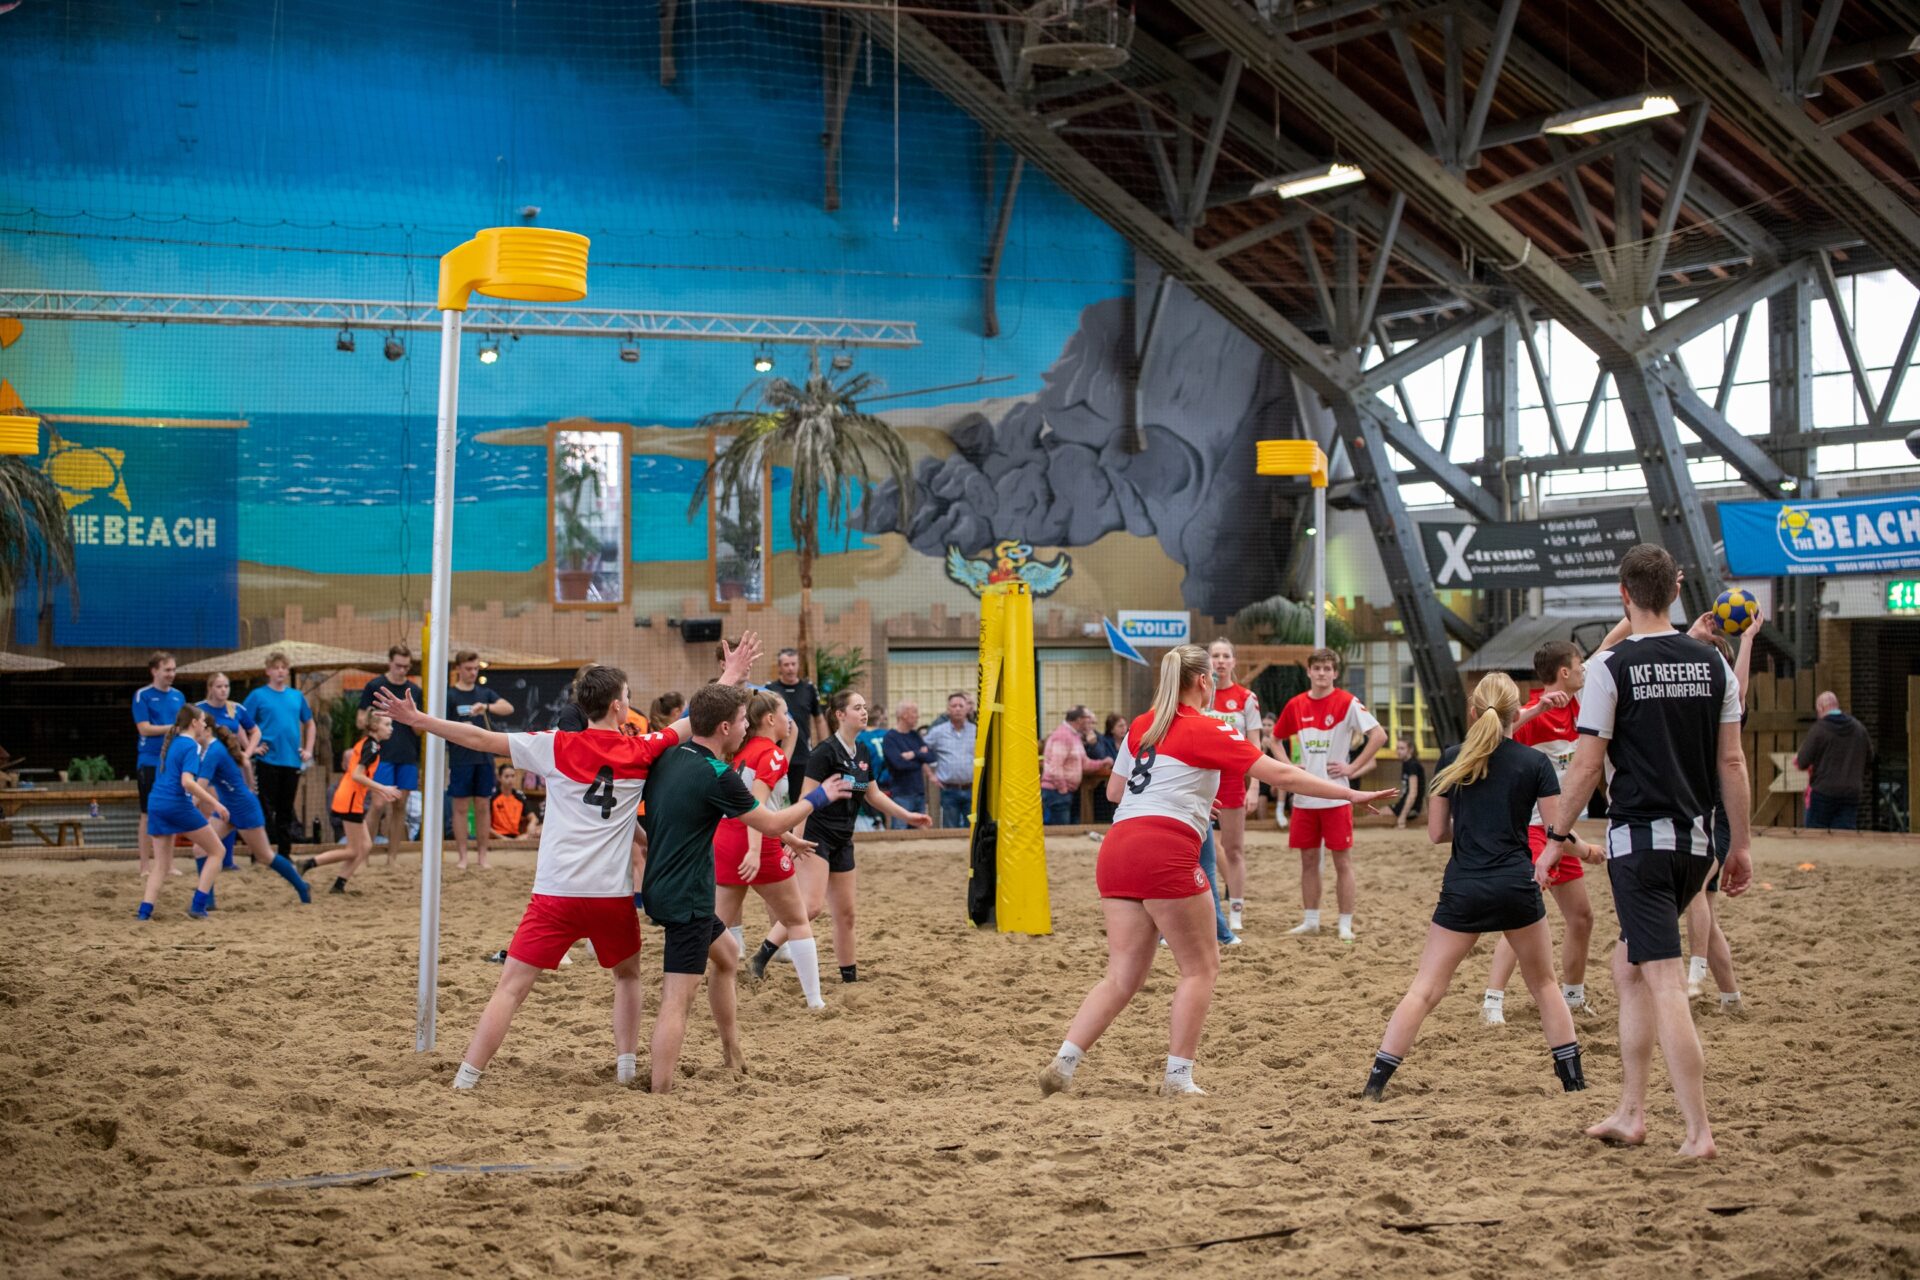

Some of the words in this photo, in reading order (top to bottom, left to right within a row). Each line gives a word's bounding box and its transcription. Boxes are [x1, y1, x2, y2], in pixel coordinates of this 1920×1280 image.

[65, 514, 99, 545] HE
[103, 514, 216, 549] BEACH
[1792, 537, 1814, 551] THE
[1810, 508, 1920, 550] BEACH
[1135, 622, 1185, 636] TOILET
[1629, 664, 1652, 684] IKF
[1654, 662, 1712, 682] REFEREE
[1632, 684, 1667, 700] BEACH
[1666, 682, 1712, 698] KORFBALL
[1127, 744, 1156, 794] 8
[583, 765, 617, 819] 4
